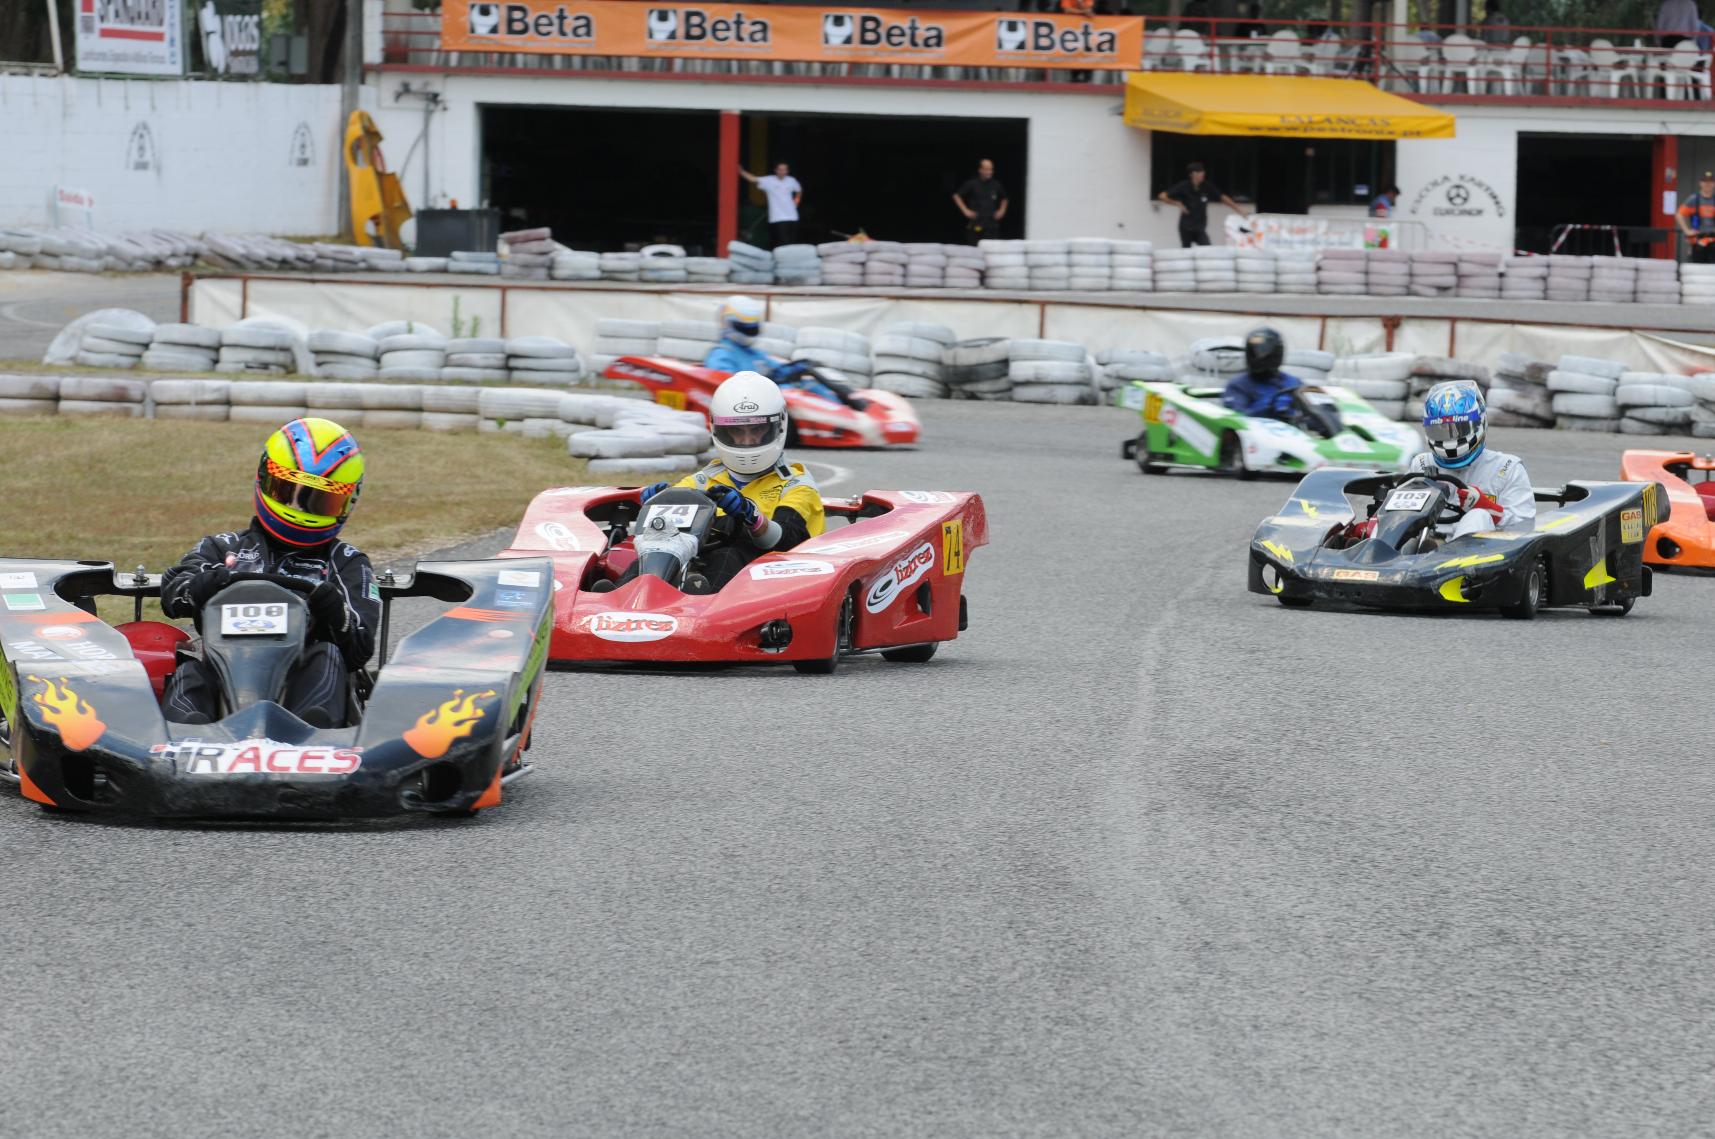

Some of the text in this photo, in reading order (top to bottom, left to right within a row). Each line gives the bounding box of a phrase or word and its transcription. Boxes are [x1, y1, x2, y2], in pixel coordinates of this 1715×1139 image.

[505, 5, 593, 38] Beta
[684, 11, 769, 43] Beta
[859, 15, 944, 49] Beta
[1033, 22, 1116, 53] Beta
[738, 402, 756, 410] Arai
[1396, 492, 1428, 500] 103
[656, 505, 690, 517] 74
[1621, 511, 1641, 521] GAS
[945, 524, 961, 572] 74
[1336, 571, 1377, 580] GAS
